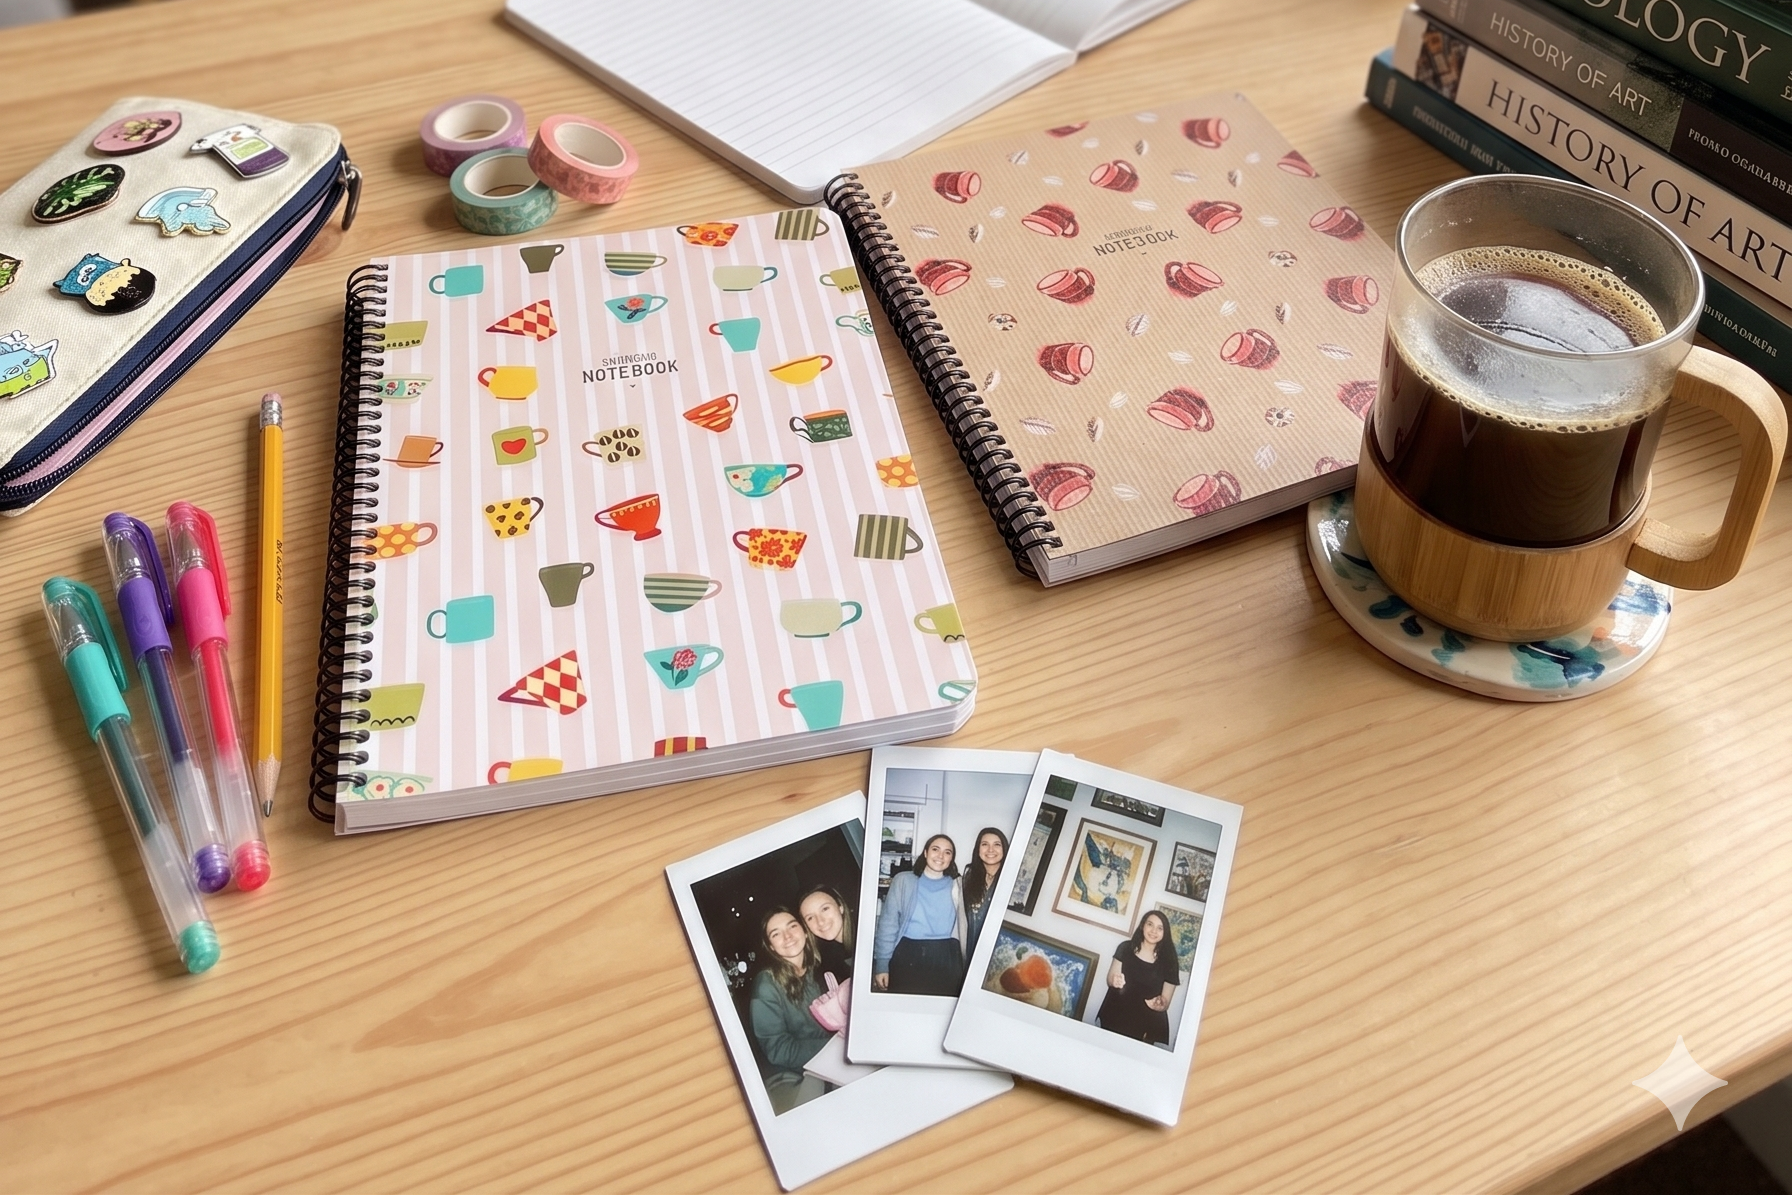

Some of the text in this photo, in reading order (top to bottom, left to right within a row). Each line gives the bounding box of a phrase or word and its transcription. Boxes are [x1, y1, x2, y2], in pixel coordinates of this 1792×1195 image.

[1490, 12, 1652, 116] HISTORY OF ART
[1487, 78, 1646, 193] HISTORY
[1650, 179, 1706, 227] OF
[1708, 217, 1792, 283] ART
[582, 360, 679, 383] NOTEBOOK
